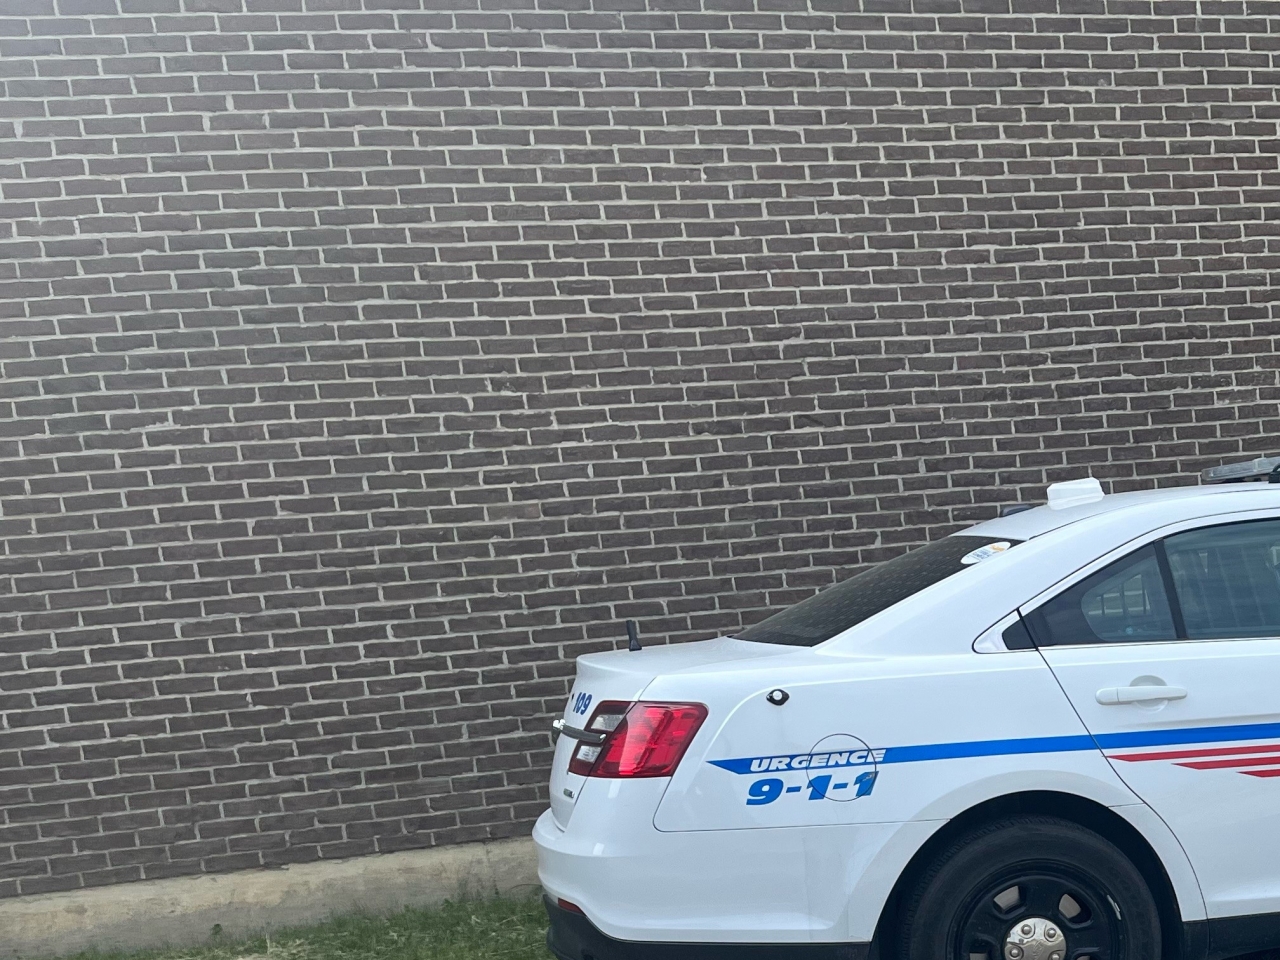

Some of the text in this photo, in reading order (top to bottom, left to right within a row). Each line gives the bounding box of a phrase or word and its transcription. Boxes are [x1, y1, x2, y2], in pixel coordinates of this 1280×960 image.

[573, 692, 593, 715] 109
[750, 749, 887, 772] URGENCE
[746, 771, 879, 806] 9-1-1
